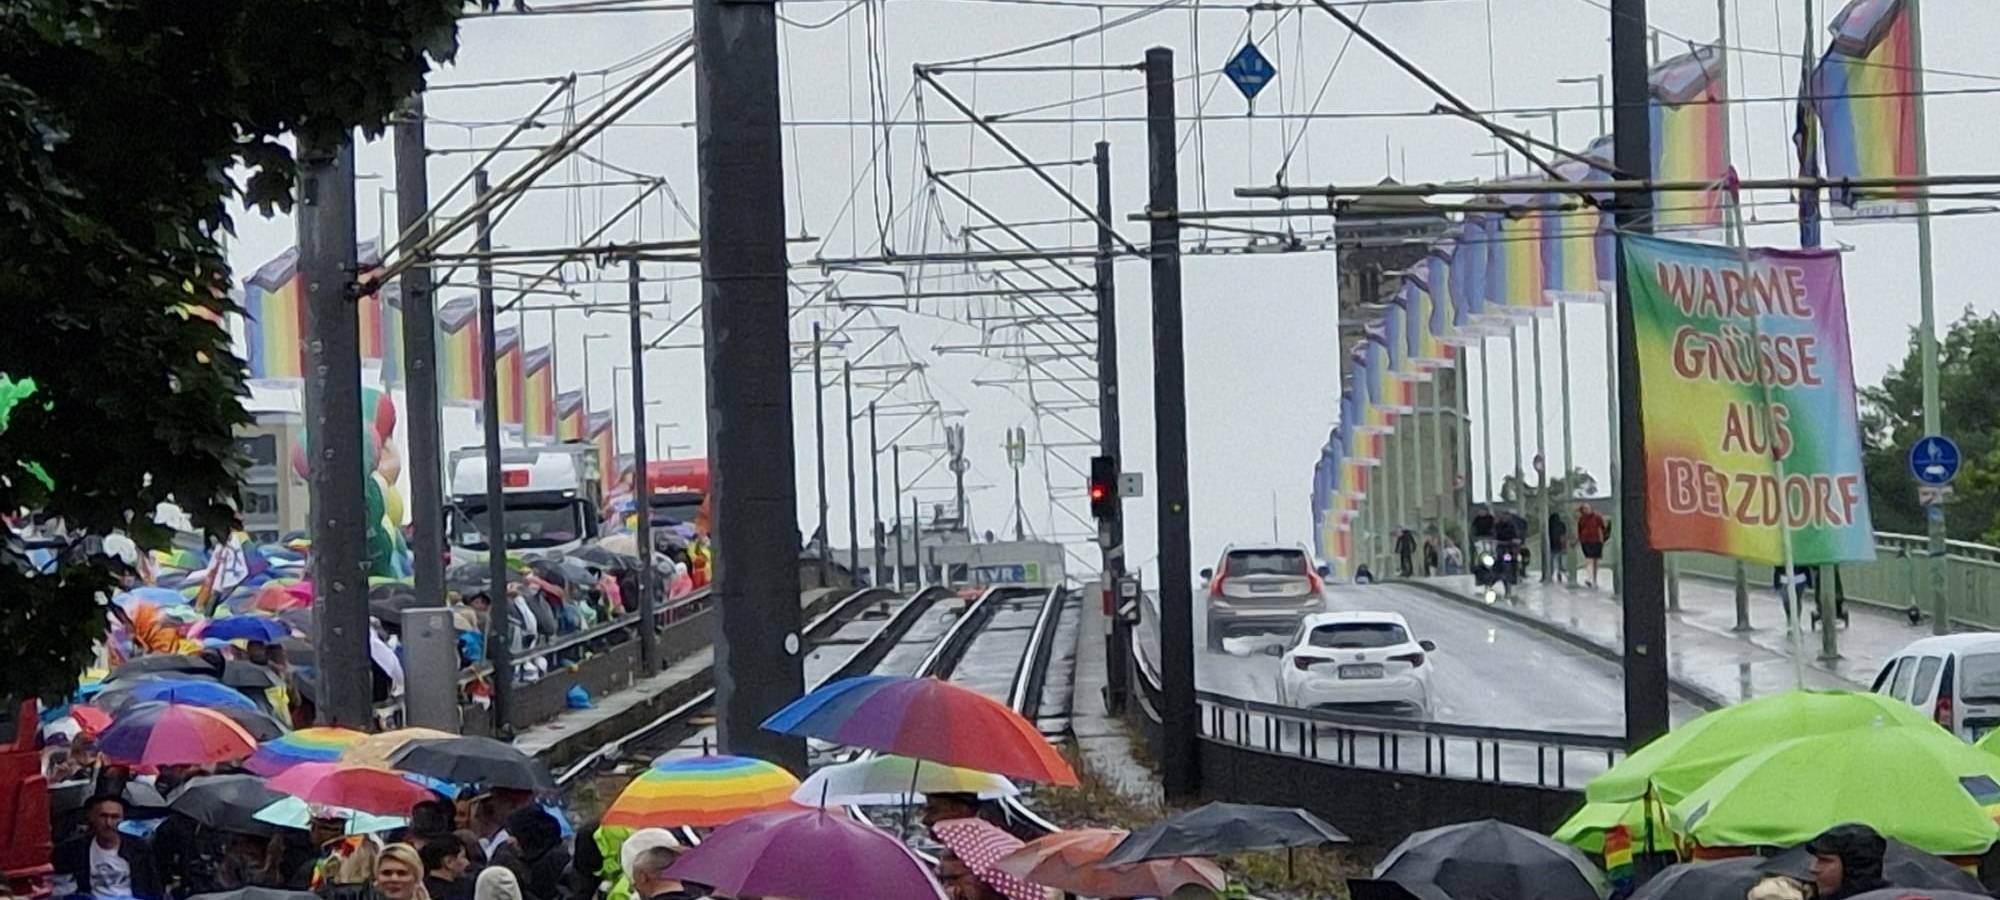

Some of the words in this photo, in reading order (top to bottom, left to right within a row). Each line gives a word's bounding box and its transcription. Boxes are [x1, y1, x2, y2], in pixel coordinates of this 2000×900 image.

[1657, 261, 1813, 318] WARME
[1673, 325, 1823, 387] GRÜSSE
[1721, 401, 1792, 459] AUS
[1665, 458, 1859, 528] BERZDORF
